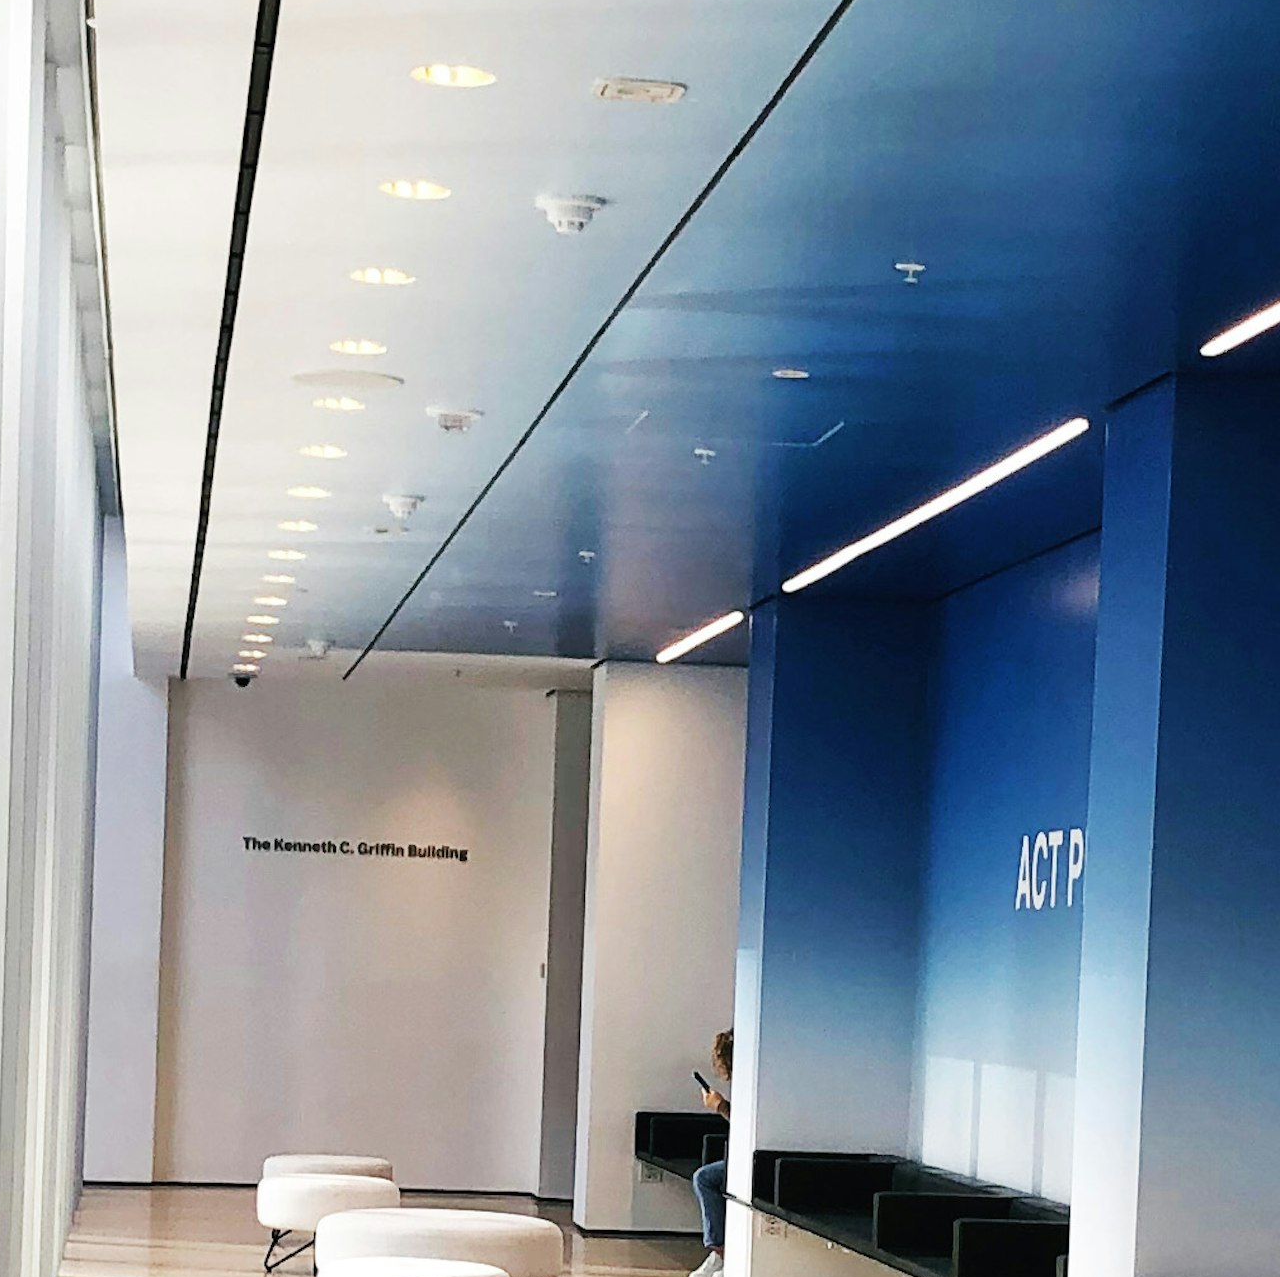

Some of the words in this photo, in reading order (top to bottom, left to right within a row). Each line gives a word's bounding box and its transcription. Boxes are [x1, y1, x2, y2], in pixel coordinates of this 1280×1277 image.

[242, 837, 271, 852] The
[274, 838, 337, 854] Kenneth
[340, 841, 355, 855] C.
[357, 842, 405, 858] Griffin
[408, 844, 469, 862] Building
[1015, 830, 1064, 911] ACT
